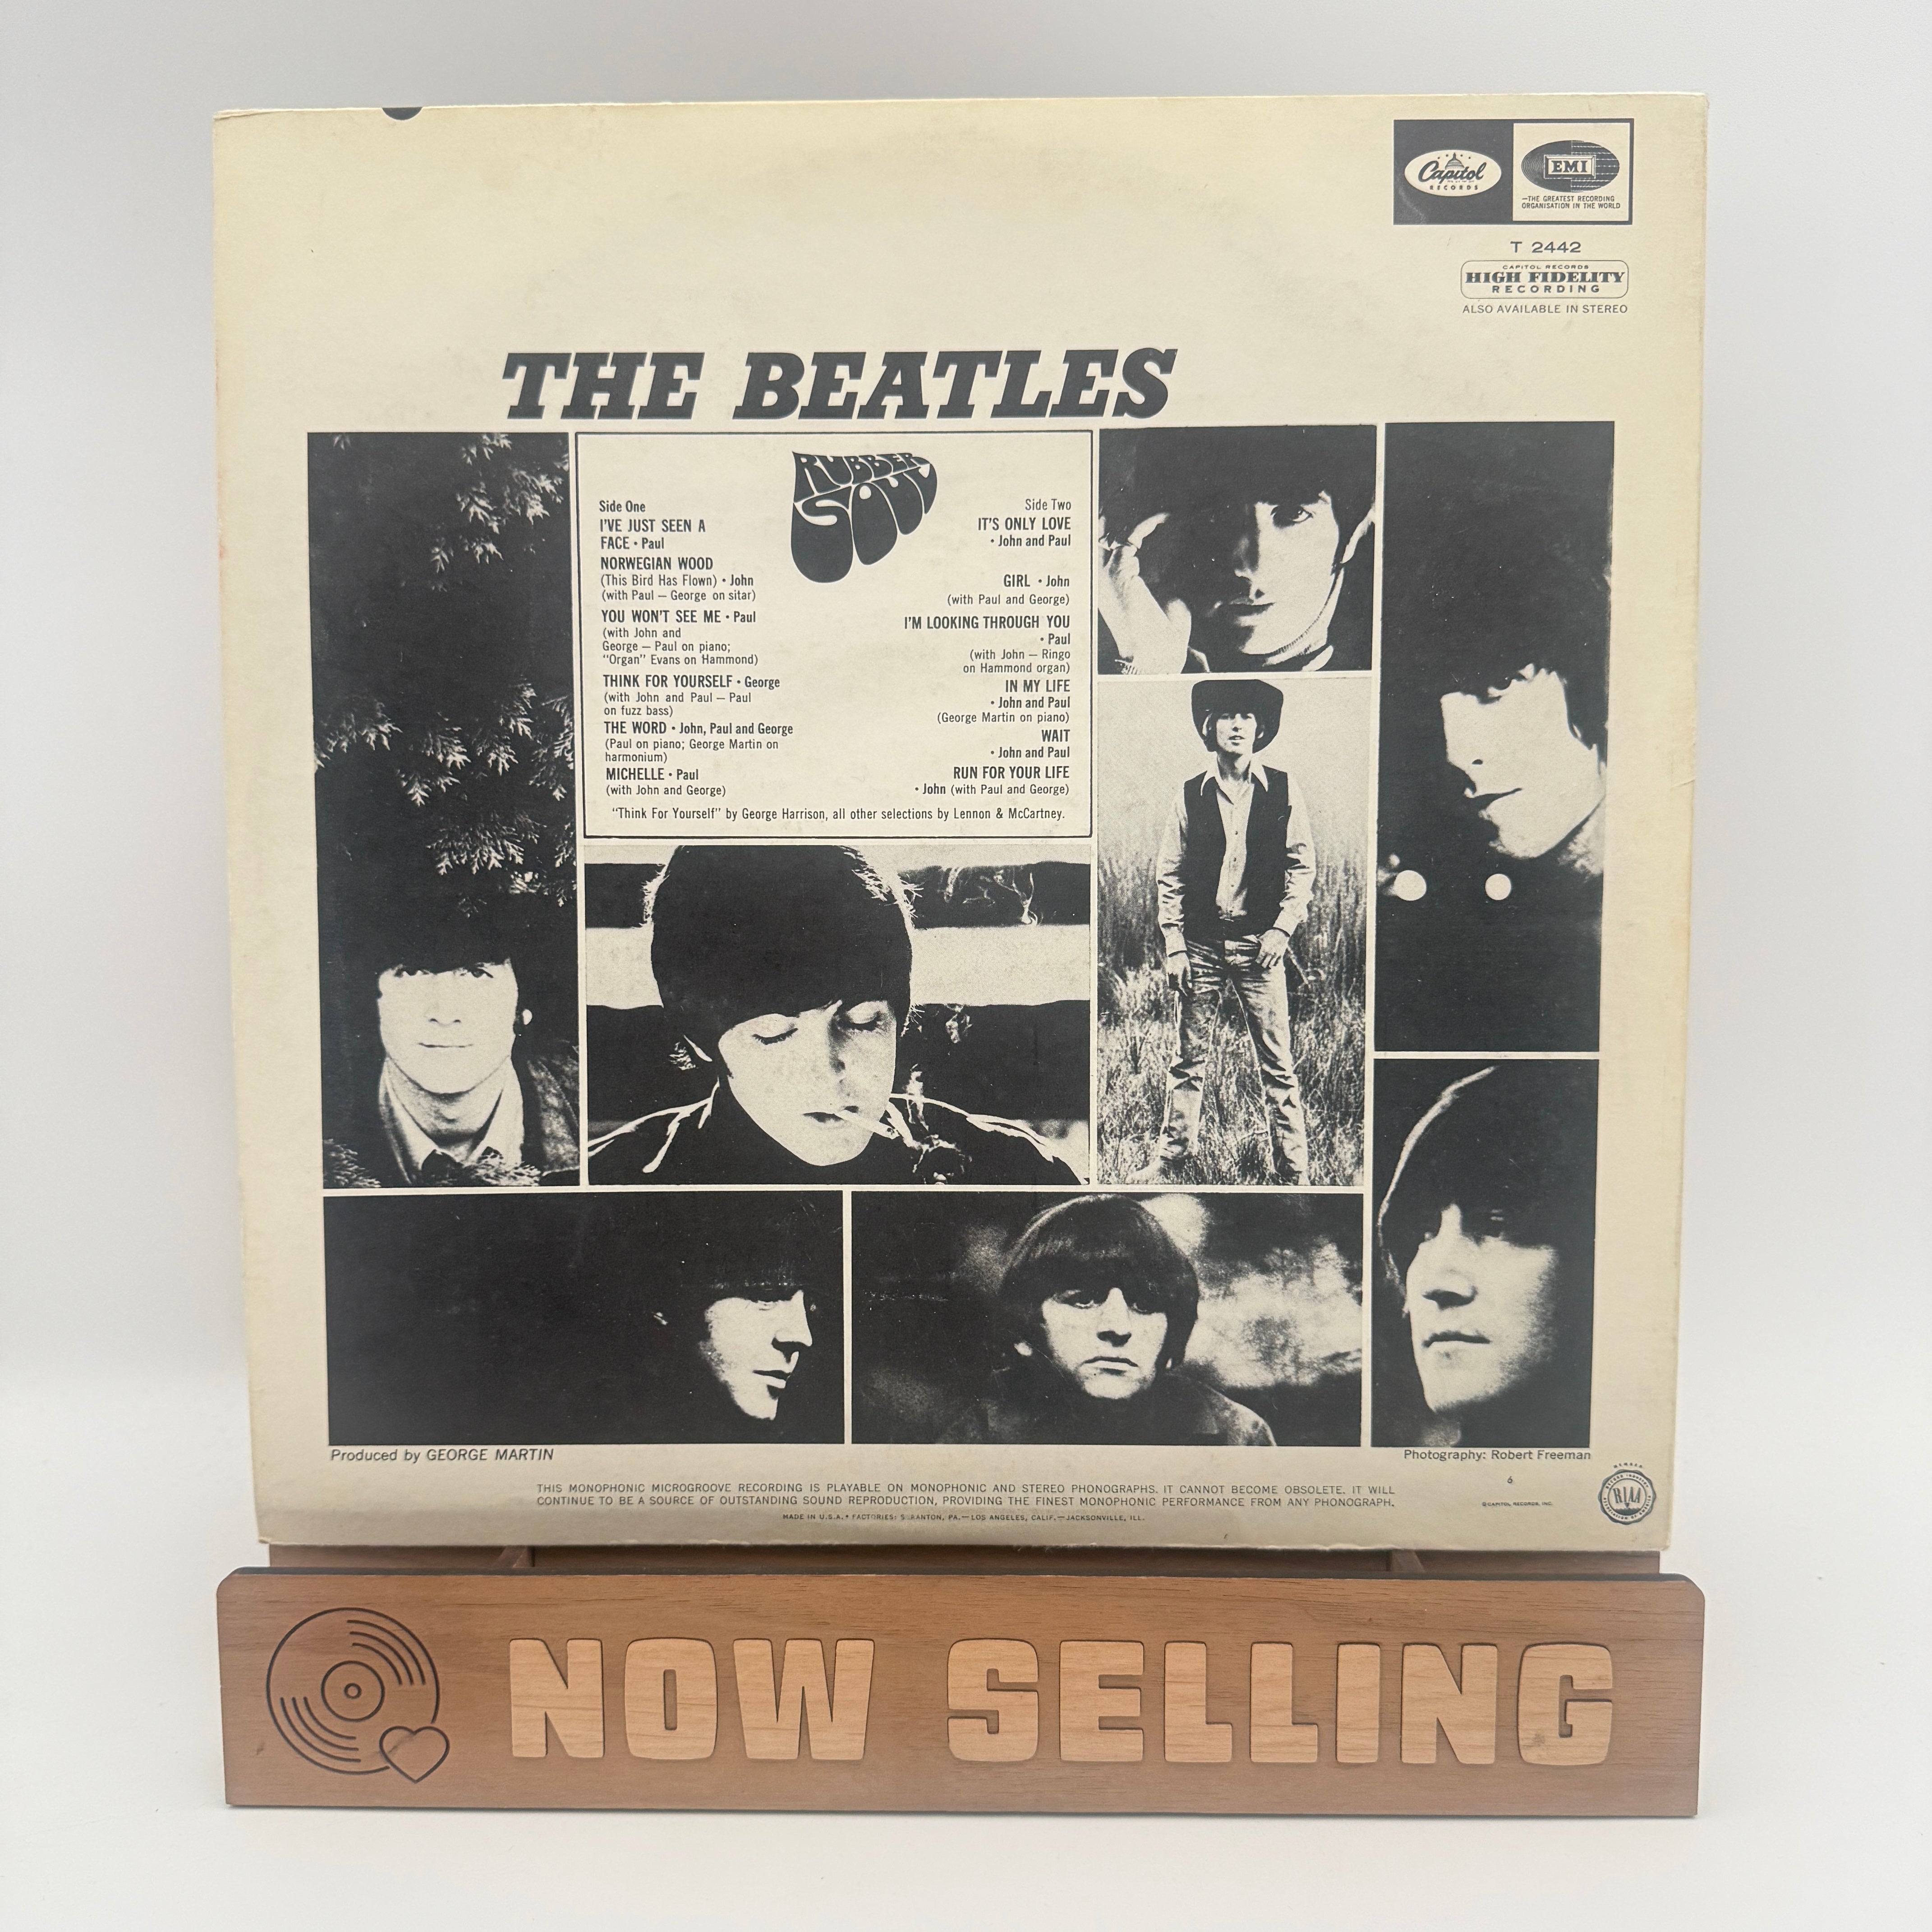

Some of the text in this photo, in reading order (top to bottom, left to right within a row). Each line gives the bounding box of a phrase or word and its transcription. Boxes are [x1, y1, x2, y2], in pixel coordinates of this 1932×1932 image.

[1418, 160, 1486, 183] Capitol
[1551, 161, 1588, 173] EMI
[1510, 241, 1581, 253] T 2442
[1465, 271, 1625, 283] HIGH FIDELITY
[1492, 285, 1599, 293] RECORDING
[1463, 304, 1628, 313] ALSO AVAILABLE IN STEREO
[502, 347, 1178, 419] THE BEATLES
[792, 451, 920, 503] RUBBER
[599, 500, 645, 512] Side One
[1025, 498, 1071, 511] Side Two
[600, 519, 705, 532] I'VE JUST SEEN A
[791, 463, 938, 584] SOUL
[978, 517, 1071, 530] IT'S ONLY LOVE
[601, 536, 664, 549] FACE Paul
[601, 557, 713, 570] NORWEGIAN WOOD
[601, 574, 753, 588] (This Bird Has Flown) John
[1003, 574, 1069, 587] GIRL John
[601, 610, 755, 623] YOU WON'T SEE ME Paul
[905, 615, 1070, 629] I'M LOOKING THROUGH YOU
[1048, 633, 1070, 644] Paul
[603, 675, 780, 690] THINK FOR YOURSELF George
[1006, 679, 1070, 692] IN MY LIFE
[603, 721, 793, 736] THE WORD John, Paul and George
[1041, 729, 1070, 742] WAIT
[607, 768, 698, 780] MICHELLE Paul
[954, 766, 1069, 779] RUN FOR YOUR LIFE
[922, 783, 1069, 796] John (with Paul and George)
[612, 807, 1064, 823] "Think For Yourself" by George Harrison, all other selections by Lennon & McCartney.
[331, 1449, 554, 1464] Produced by GEORGE MARTIN
[1404, 1449, 1591, 1462] Photography: Robert Freeman
[537, 1484, 562, 1492] THIS
[569, 1484, 644, 1492] MONOPHONIC
[652, 1484, 731, 1492] MICROGROOVE
[739, 1483, 802, 1492] RECORDING
[810, 1484, 820, 1492] IS
[827, 1484, 880, 1492] PLAYABLE
[888, 1484, 902, 1492] ON
[911, 1484, 986, 1492] MONOPHONIC
[993, 1484, 1015, 1492] AND
[1022, 1484, 1064, 1493] STEREO
[1072, 1485, 1158, 1493] PHONOGRAPHS.
[1164, 1485, 1173, 1493] IT
[1180, 1485, 1224, 1494] CANNOT
[1232, 1486, 1278, 1494] BECOME
[1285, 1486, 1345, 1494] OBSOLETE.
[537, 1496, 1394, 1507] CONTINUE TO BE A SOURCE OF OUTSTANDING SOUND REPRODUCTION, PROVIDING THE FINEST MONOPHONIC PERFORMANCE FROM ANY PHONOGRAPH.
[508, 1638, 1615, 1764] NOW SELLING
